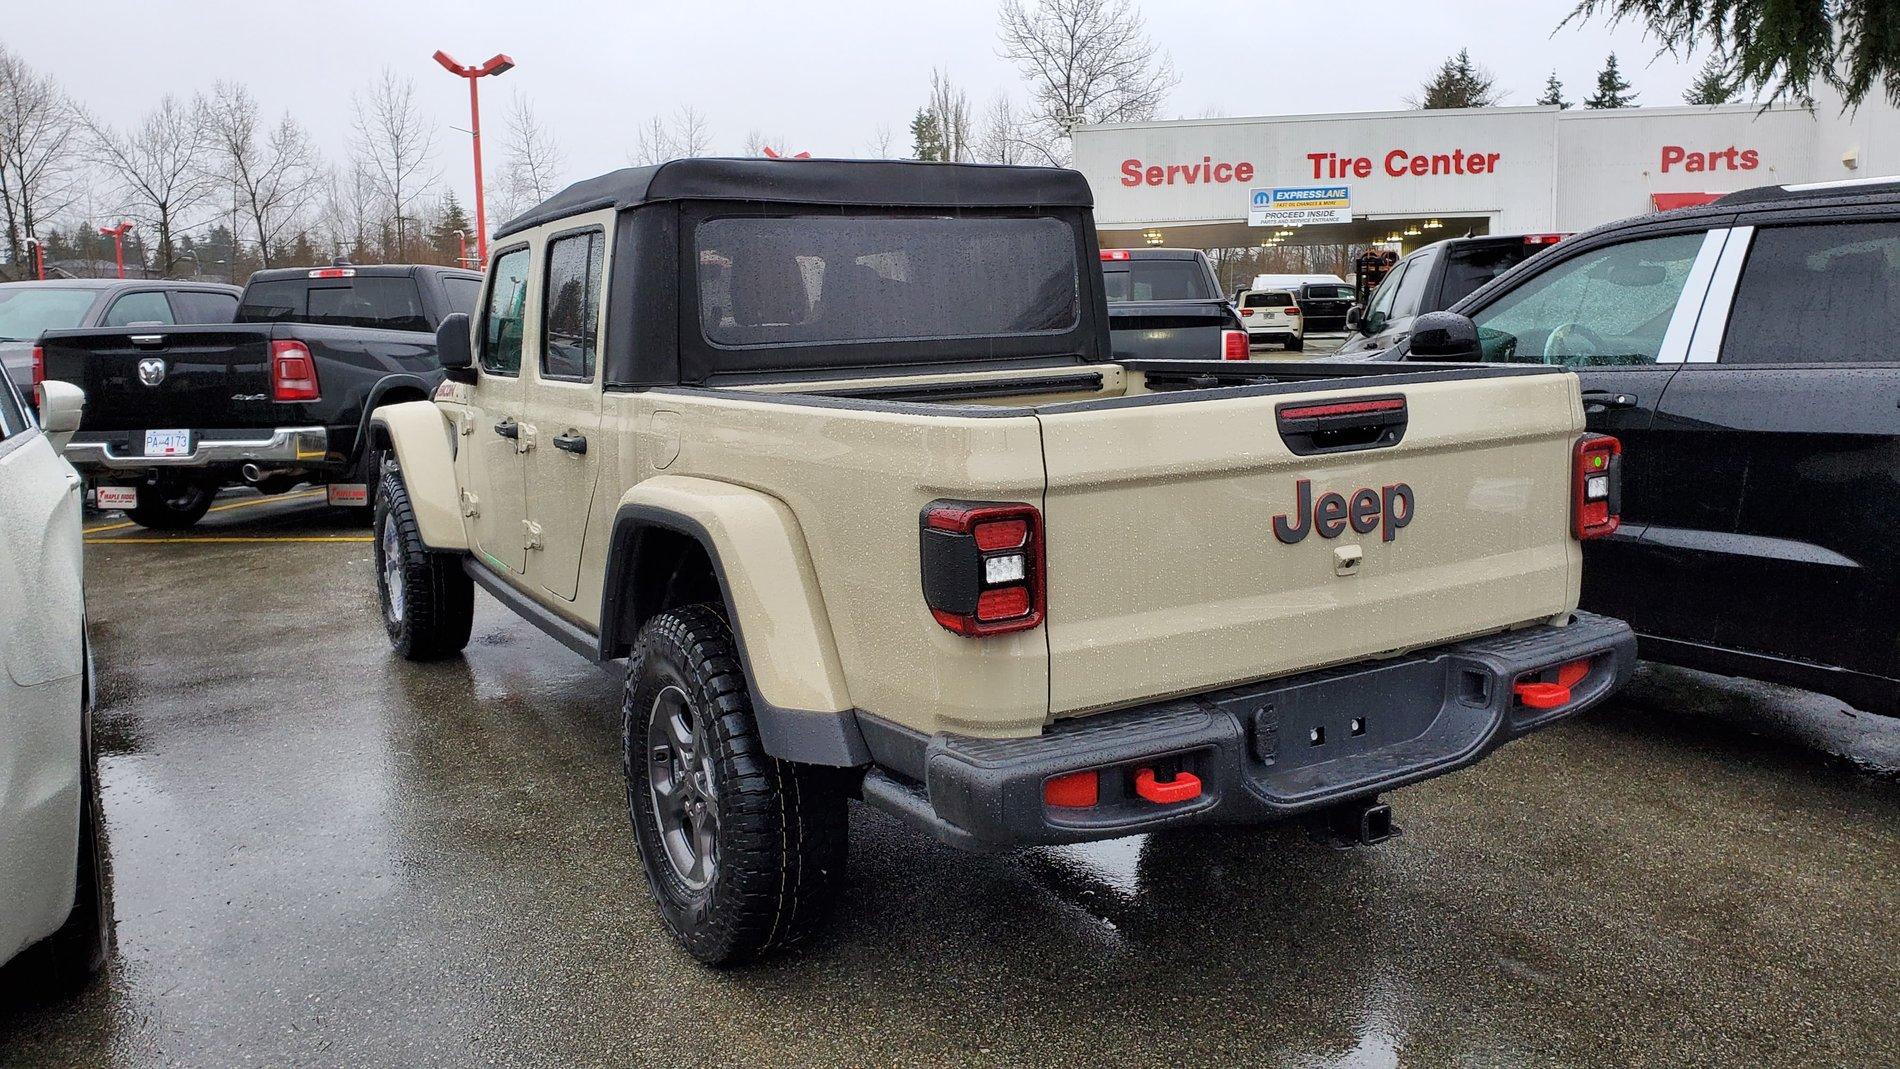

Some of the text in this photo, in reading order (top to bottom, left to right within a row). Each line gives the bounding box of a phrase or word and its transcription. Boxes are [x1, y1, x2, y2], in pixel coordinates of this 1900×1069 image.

[1120, 156, 1254, 187] Service
[1307, 149, 1500, 180] Tire Center
[1661, 145, 1759, 174] Parts
[1276, 188, 1346, 200] EXPRESSLANE
[1265, 211, 1304, 219] PROCEED
[1272, 479, 1415, 545] Jeep
